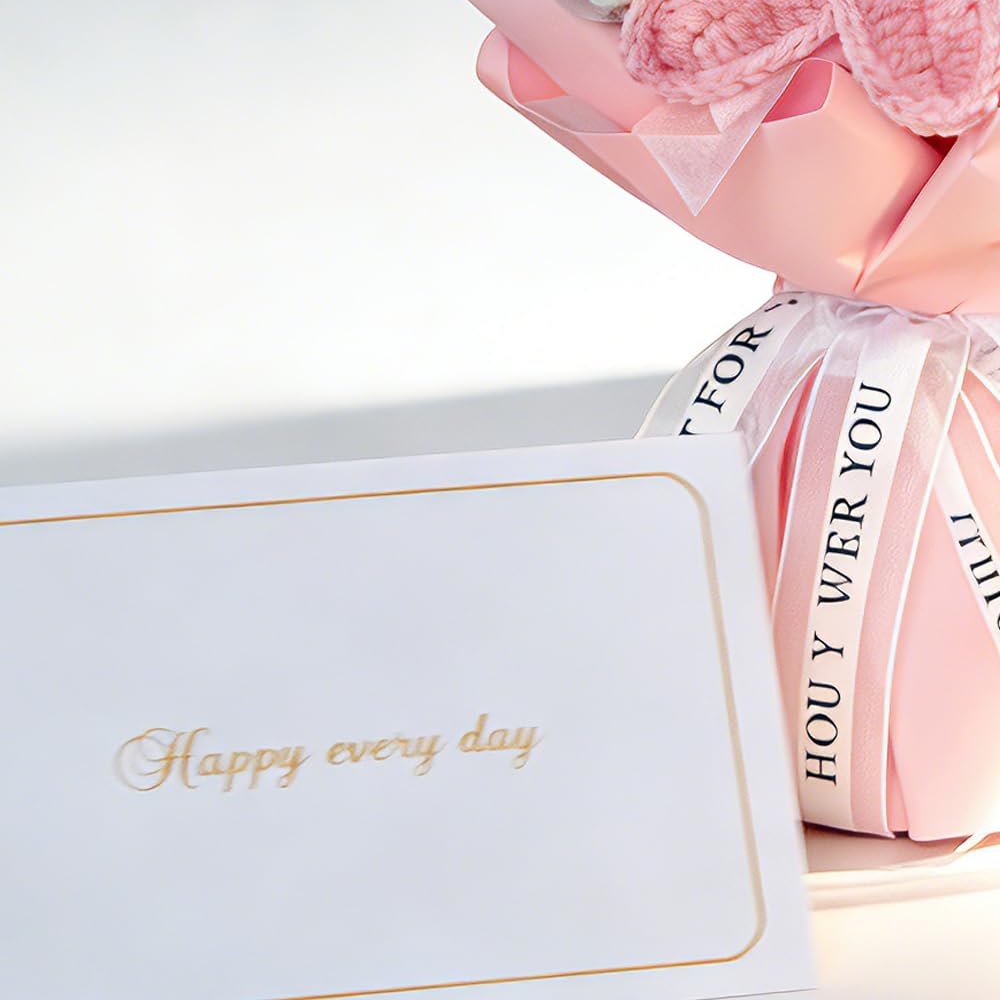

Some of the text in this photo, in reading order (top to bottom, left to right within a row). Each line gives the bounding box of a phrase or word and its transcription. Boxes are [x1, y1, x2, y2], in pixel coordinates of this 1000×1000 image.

[693, 326, 774, 413] FOR
[839, 381, 892, 477] YOU
[816, 494, 868, 607] WER
[116, 712, 542, 793] Happy every day
[805, 678, 841, 786] HOU
